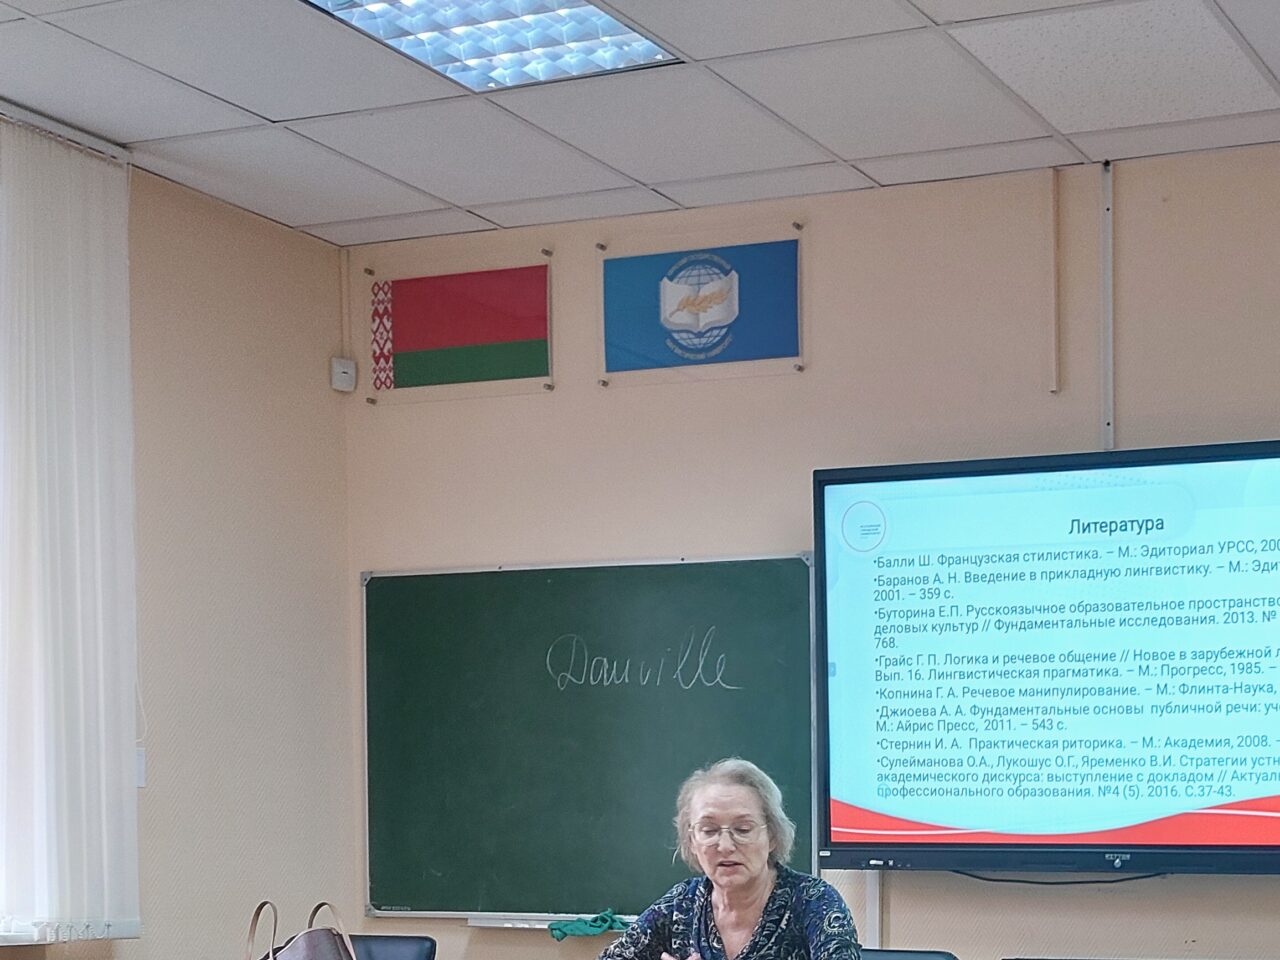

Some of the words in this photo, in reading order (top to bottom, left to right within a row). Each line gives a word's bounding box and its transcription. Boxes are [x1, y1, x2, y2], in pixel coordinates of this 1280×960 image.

[1068, 517, 1165, 537] Литература
[877, 554, 915, 568] Балли
[936, 550, 1019, 568] Французская
[1022, 548, 1102, 562] стилистика.
[1139, 542, 1216, 559] Эдиториал
[1217, 540, 1259, 556] УРСС,
[877, 572, 929, 588] Баранов
[963, 568, 1026, 585] Введение
[1040, 566, 1121, 582] прикладную
[1124, 563, 1212, 579] лингвистику.
[872, 587, 906, 600] 2001.
[919, 587, 941, 599] 359
[877, 605, 935, 621] Буторина
[966, 601, 1066, 619] Русскоязычное
[1068, 597, 1185, 615] образовательное
[873, 622, 929, 636] деловых
[930, 620, 979, 635] культур
[993, 614, 1115, 632] Фундаментальные
[1118, 613, 1219, 628] исследования.
[1222, 609, 1258, 622] 2013.
[878, 653, 913, 668] Грайс
[942, 651, 989, 664] Логика
[1000, 652, 1056, 666] речевое
[1057, 649, 1116, 665] общение
[1132, 647, 1176, 660] Новое
[1189, 645, 1272, 662] зарубежной
[927, 666, 1040, 680] Лингвистическая
[1042, 666, 1122, 680] прагматика.
[1160, 662, 1226, 678] Прогресс,
[1229, 661, 1264, 674] 1985.
[879, 685, 932, 698] Копнина
[961, 684, 1016, 697] Речевое
[1018, 684, 1140, 698] манипулирование.
[1177, 680, 1277, 696] Флинта-Наука,
[879, 704, 936, 719] Джиоева
[969, 702, 1090, 718] Фундаментальные
[1092, 703, 1144, 714] основы
[1150, 700, 1222, 716] публичной
[1225, 702, 1261, 715] речи:
[895, 718, 934, 733] Айрис
[937, 718, 979, 733] Пресс,
[983, 718, 1016, 730] 2011.
[1031, 718, 1055, 730] 543
[880, 736, 931, 751] Стернин
[968, 736, 1058, 751] Практическая
[1061, 737, 1126, 750] риторика.
[1163, 734, 1235, 749] Академия,
[1236, 734, 1271, 746] 2008.
[880, 755, 963, 769] Сулейманова
[966, 755, 994, 769] О.А.,
[995, 754, 1052, 769] Лукошус
[1054, 754, 1078, 769] О.Г.,
[1081, 754, 1146, 769] Яременко
[1178, 754, 1247, 769] Стратегии
[876, 771, 979, 784] академического
[981, 771, 1043, 784] дискурса:
[1046, 771, 1133, 784] выступление
[1146, 770, 1214, 783] докладом
[1006, 784, 1094, 799] образования.
[1145, 784, 1181, 796] 2016.
[1184, 784, 1237, 796] С.37-43.
